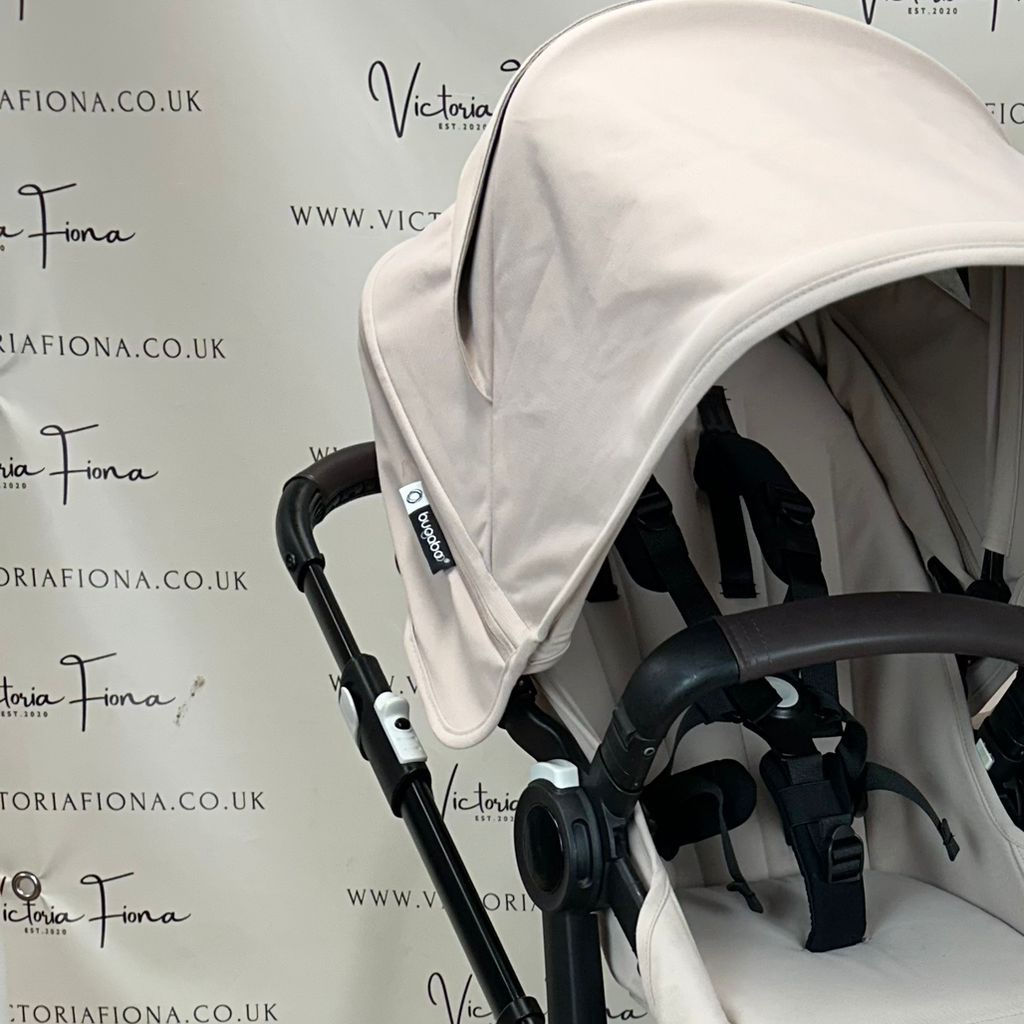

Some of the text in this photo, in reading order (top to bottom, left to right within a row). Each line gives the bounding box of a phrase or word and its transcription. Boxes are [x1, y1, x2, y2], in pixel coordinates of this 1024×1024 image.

[368, 60, 493, 138] Victoria
[18, 183, 136, 269] Fiona
[40, 424, 159, 505] Fiona
[60, 653, 176, 732] Fiona
[80, 872, 192, 949] Fiona
[9, 1003, 279, 1024] TORIAFIONA.CO.UK
